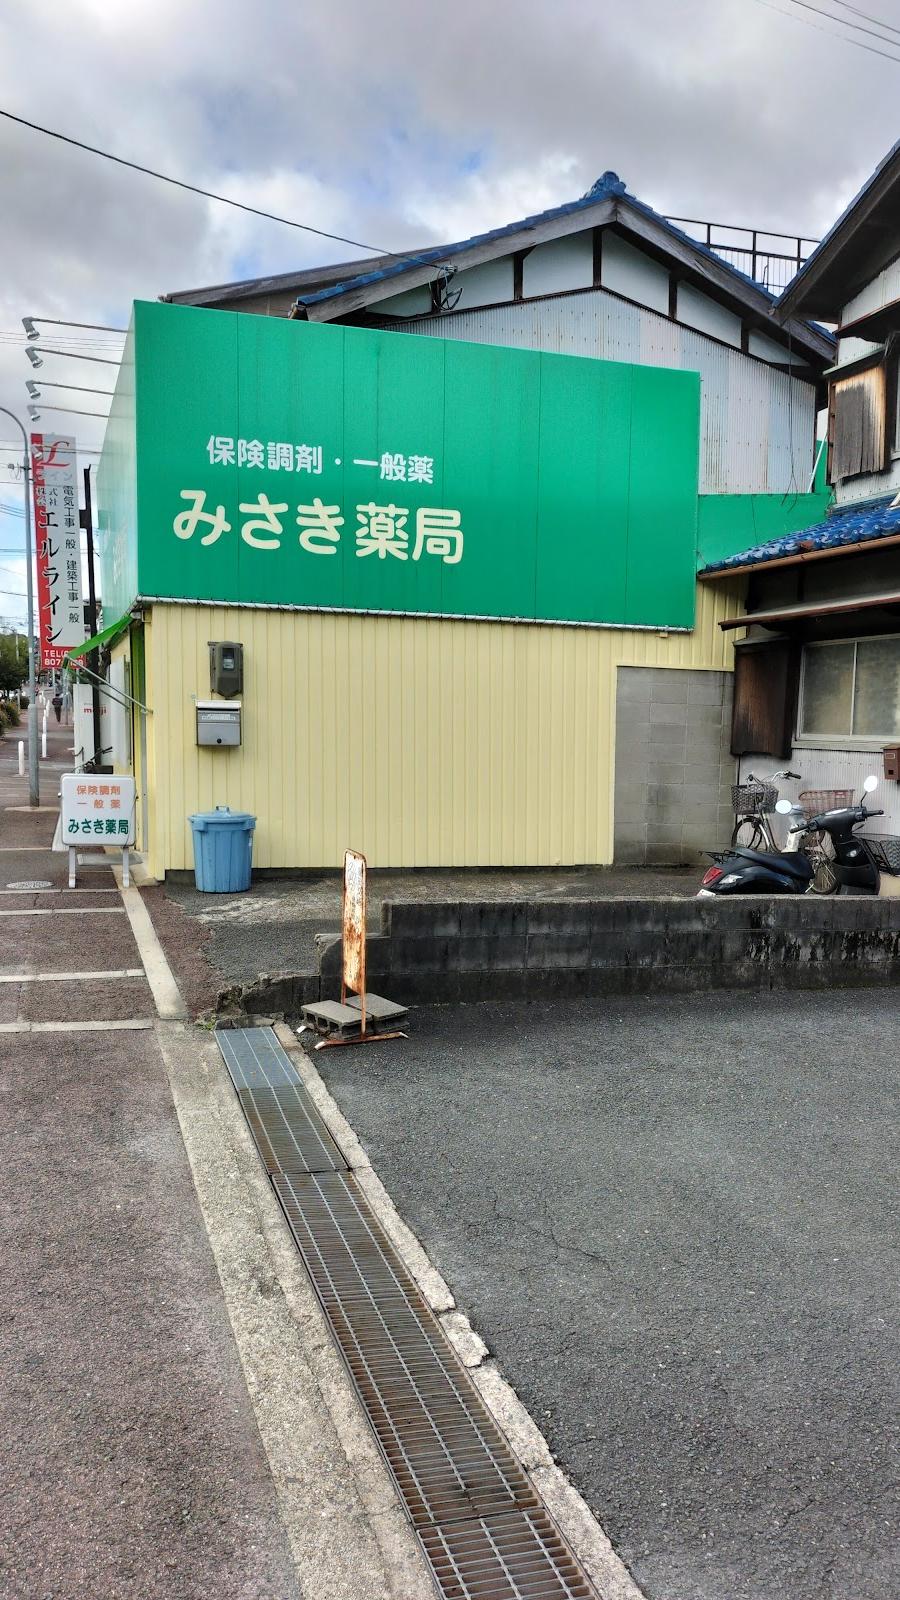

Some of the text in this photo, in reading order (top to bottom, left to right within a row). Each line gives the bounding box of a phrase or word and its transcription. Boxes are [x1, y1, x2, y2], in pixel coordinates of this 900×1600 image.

[206, 435, 434, 484] 保険調剤・一般薬
[173, 489, 464, 564] みさき薬局
[39, 511, 62, 642] エルライン
[76, 785, 121, 796] 保険調剤
[68, 818, 129, 835] みさき薬局
